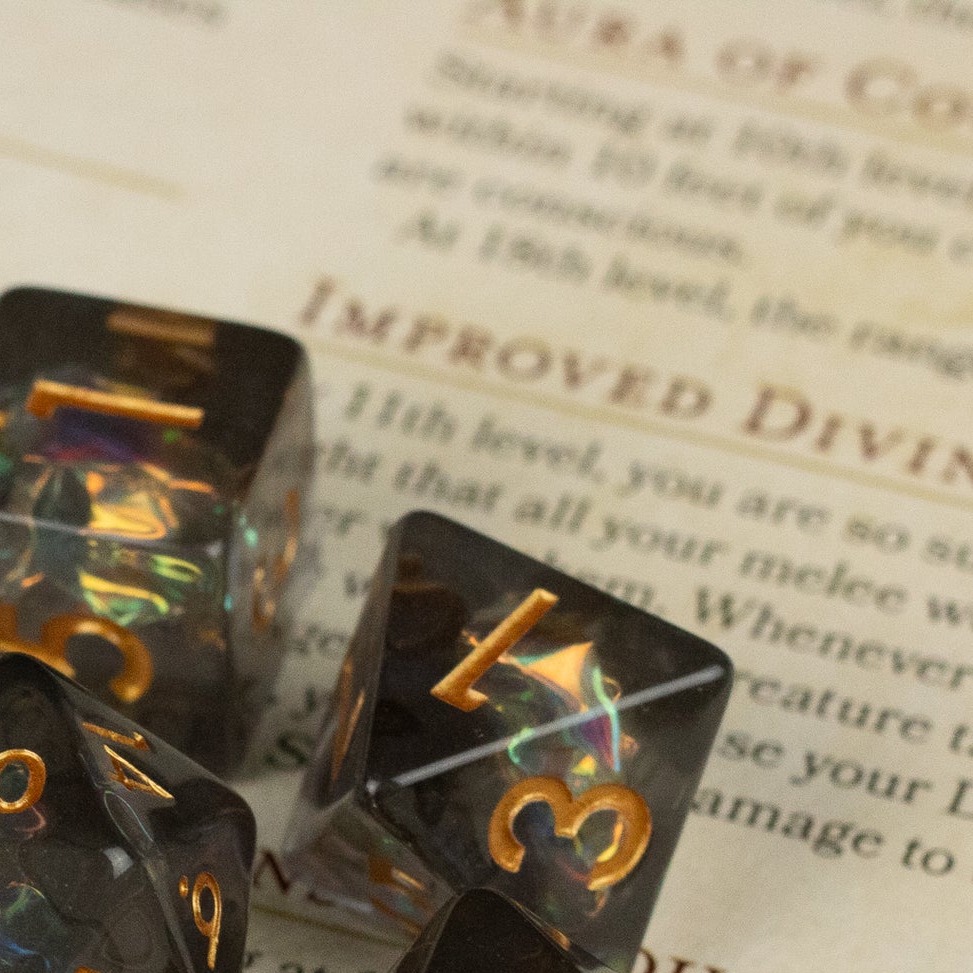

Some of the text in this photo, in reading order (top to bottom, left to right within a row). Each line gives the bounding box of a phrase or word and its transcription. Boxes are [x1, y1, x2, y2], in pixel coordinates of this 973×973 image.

[295, 273, 719, 422] IMPROVED
[732, 668, 935, 744] reature
[789, 745, 935, 808] your
[487, 775, 653, 892] 3
[901, 837, 957, 878] to
